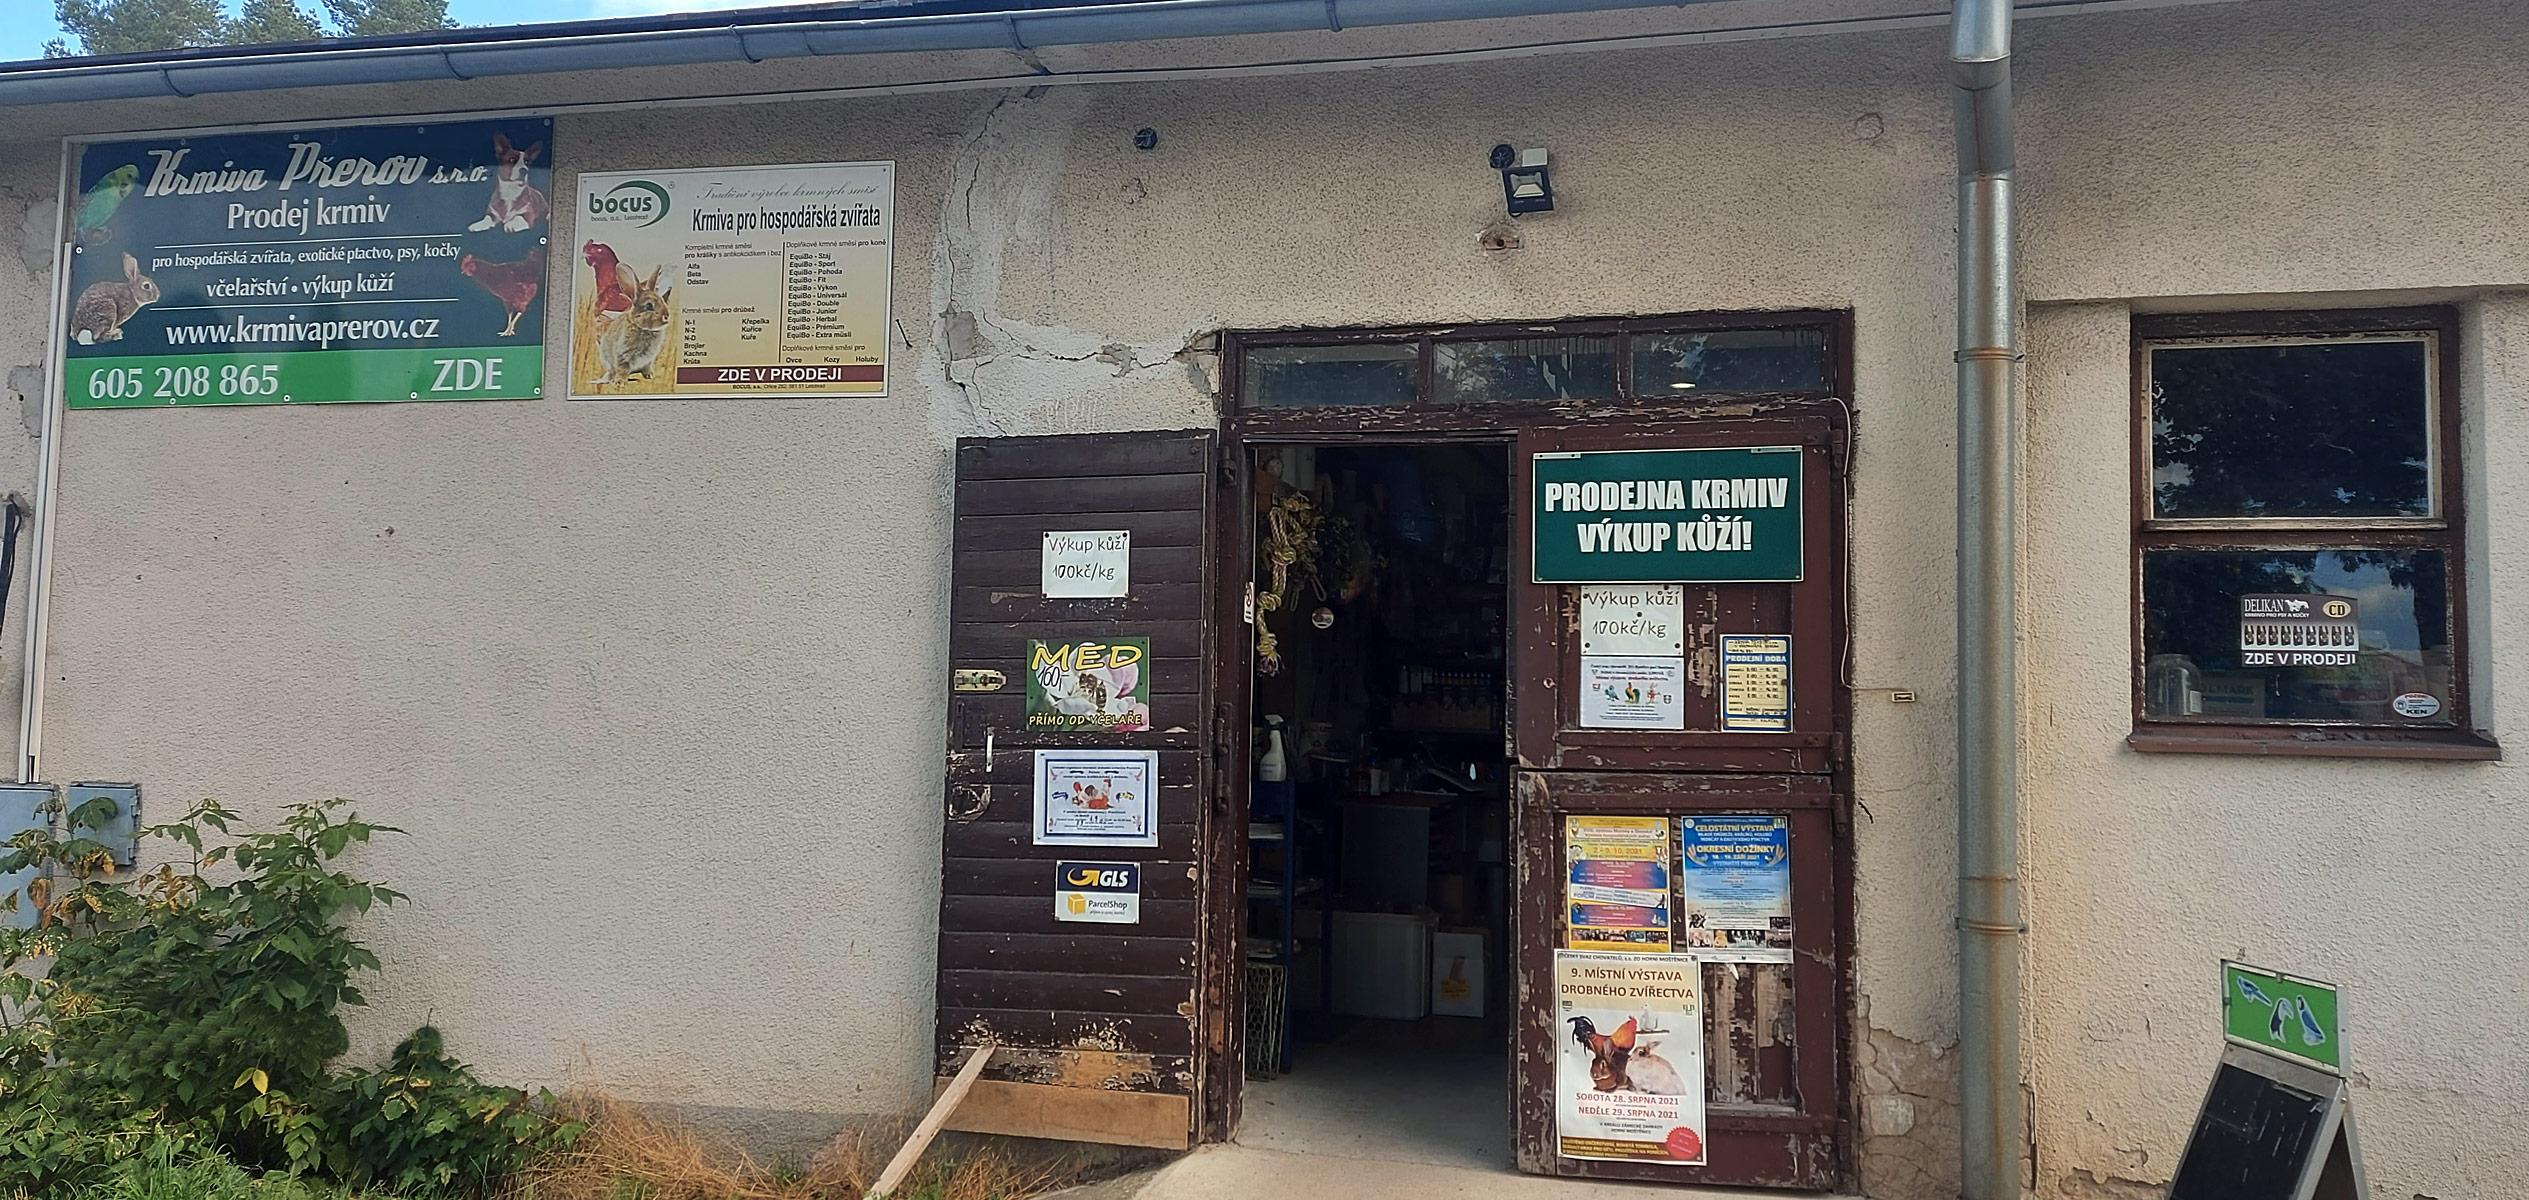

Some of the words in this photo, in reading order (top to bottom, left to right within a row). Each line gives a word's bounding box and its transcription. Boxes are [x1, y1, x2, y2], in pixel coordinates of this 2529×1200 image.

[144, 148, 266, 197] Krmiva
[278, 141, 428, 190] Přerov
[428, 166, 487, 185] s.r.o.
[589, 193, 652, 213] bocus
[227, 199, 309, 235] Prodej
[316, 196, 390, 226] krmiv
[693, 208, 733, 231] Krmiva
[736, 214, 756, 235] pro
[760, 203, 836, 234] hospodářská
[840, 203, 880, 226] zvířata
[152, 255, 172, 272] pro
[174, 247, 247, 269] hospodářská
[250, 246, 295, 266] zvířata,
[298, 245, 345, 264] exotické
[347, 244, 395, 264] ptactvo,
[397, 248, 421, 264] psy,
[423, 242, 461, 261] kočky
[206, 275, 287, 298] včelařství
[302, 274, 352, 300] výkup
[356, 271, 395, 293] kůží
[166, 314, 439, 349] www.krmivaprerov.cz
[89, 369, 144, 399] 605
[153, 367, 210, 397] 208
[220, 365, 279, 395] 865
[430, 359, 503, 392] ZDE
[718, 369, 750, 382] ZDE
[755, 369, 766, 381] V
[770, 368, 841, 381] PRODEJI
[1545, 480, 1686, 512] PRODEJNA
[1691, 478, 1788, 509] KRMIV
[1577, 518, 1670, 553] VÝKUP
[1677, 513, 1753, 551] KŮŽÍ!
[1049, 537, 1093, 555] Výkup
[1098, 536, 1127, 551] kůží
[1587, 591, 1639, 610] Výkup
[1646, 590, 1680, 606] kůží
[2244, 599, 2284, 612] DELIKAN
[2329, 605, 2346, 616] CD
[1031, 644, 1143, 673] MED
[1726, 654, 1763, 663] PRODEJNÍ
[1765, 655, 1787, 663] DOBA
[2244, 653, 2274, 665] ZDE
[2277, 653, 2289, 665] V
[2293, 653, 2356, 665] PRODEJI
[1029, 712, 1064, 726] PŘÍMO
[1070, 715, 1085, 725] OD
[1091, 711, 1142, 725] VČELAŘE
[1695, 824, 1740, 832] CELOSTÁTNÍ
[1741, 824, 1774, 832] VÝSTAVA
[1696, 844, 1734, 853] OKRESNÍ
[1735, 844, 1775, 853] DOŽÍNKY
[1100, 870, 1129, 887] GLS
[1088, 900, 1128, 911] ParcelShop
[1571, 968, 1582, 978] 9.
[1585, 967, 1626, 980] MÍSTNÍ
[1628, 969, 1682, 981] VÝSTAVA
[1561, 984, 1627, 997] DROBNÉHO
[1630, 985, 1694, 999] ZVÍŘECTVA
[1576, 1093, 1611, 1103] SOBOTA
[1613, 1095, 1626, 1103] 28.
[1628, 1095, 1656, 1105] SRPNA
[1659, 1097, 1679, 1106] 2021
[1578, 1106, 1610, 1116] NEDĚLE
[1612, 1108, 1625, 1117] 29.
[1627, 1109, 1656, 1118] SRPNA
[1658, 1110, 1679, 1119] 2021
